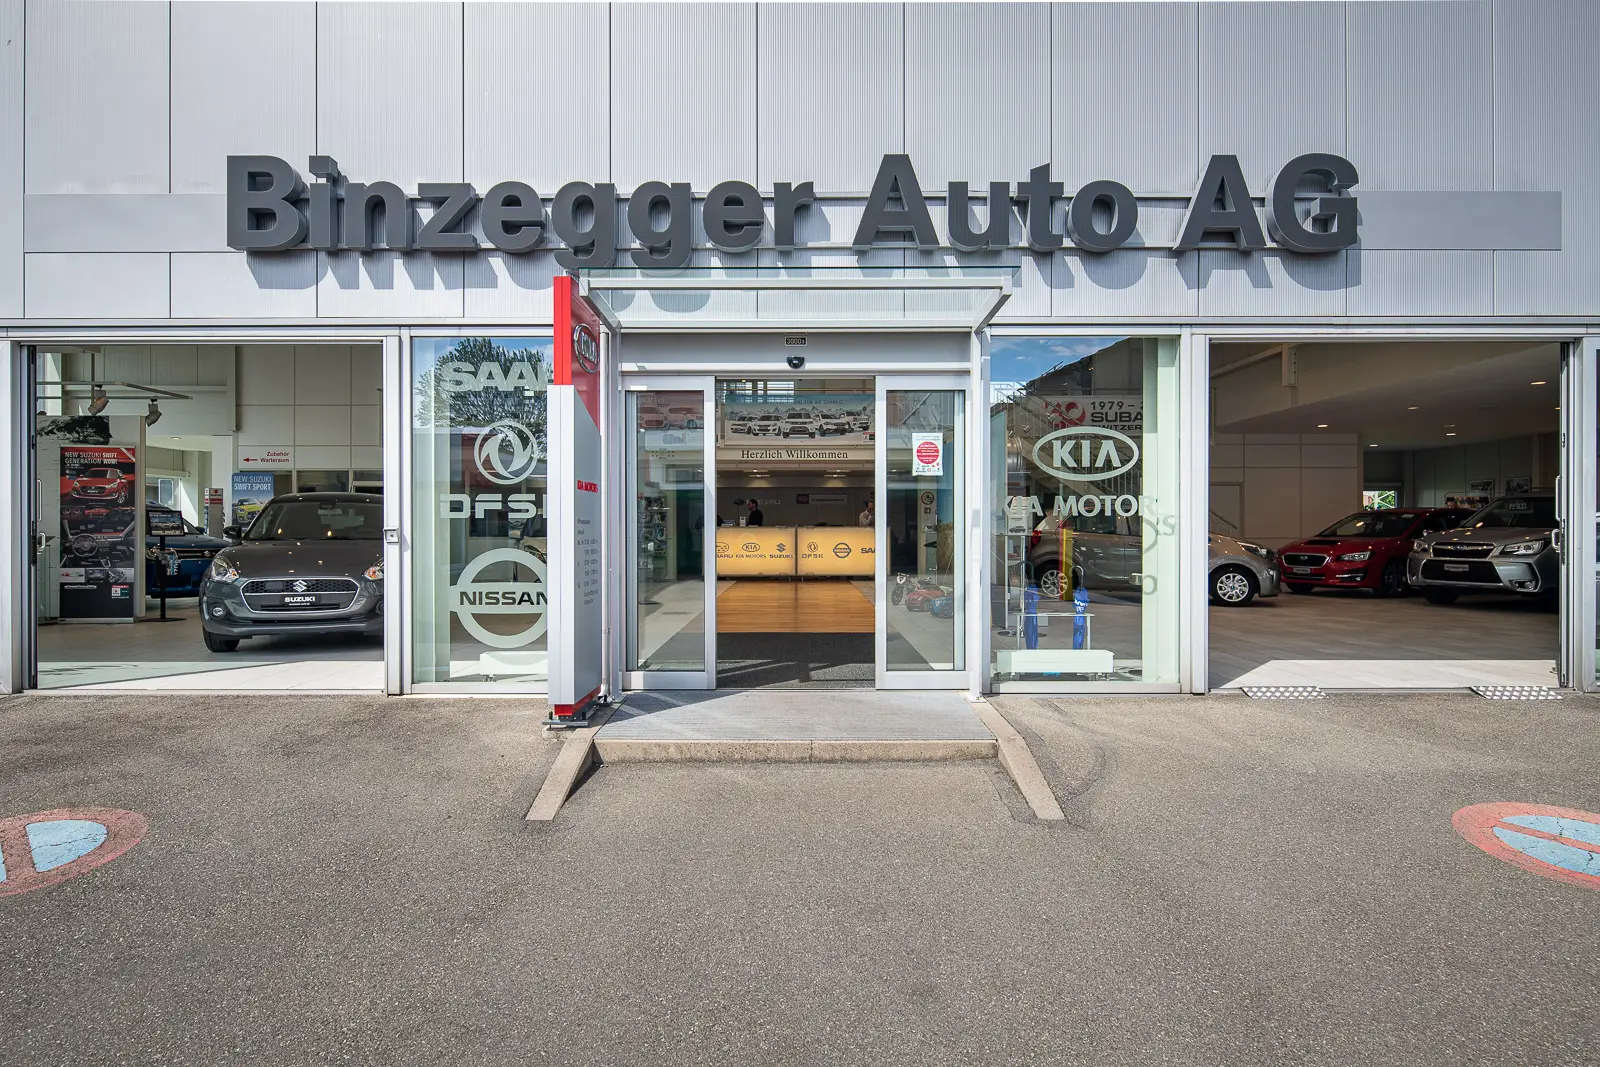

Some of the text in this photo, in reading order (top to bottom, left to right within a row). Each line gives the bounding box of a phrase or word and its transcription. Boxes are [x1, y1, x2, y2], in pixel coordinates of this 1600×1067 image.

[227, 153, 1359, 270] Binzegger Auto AG
[1091, 401, 1124, 410] 1979
[741, 450, 848, 459] Herzlich Willkommen
[1052, 440, 1121, 467] KIA
[234, 483, 271, 491] SWIFT SPORT
[440, 493, 547, 518] DFS
[997, 494, 1044, 517] KIA
